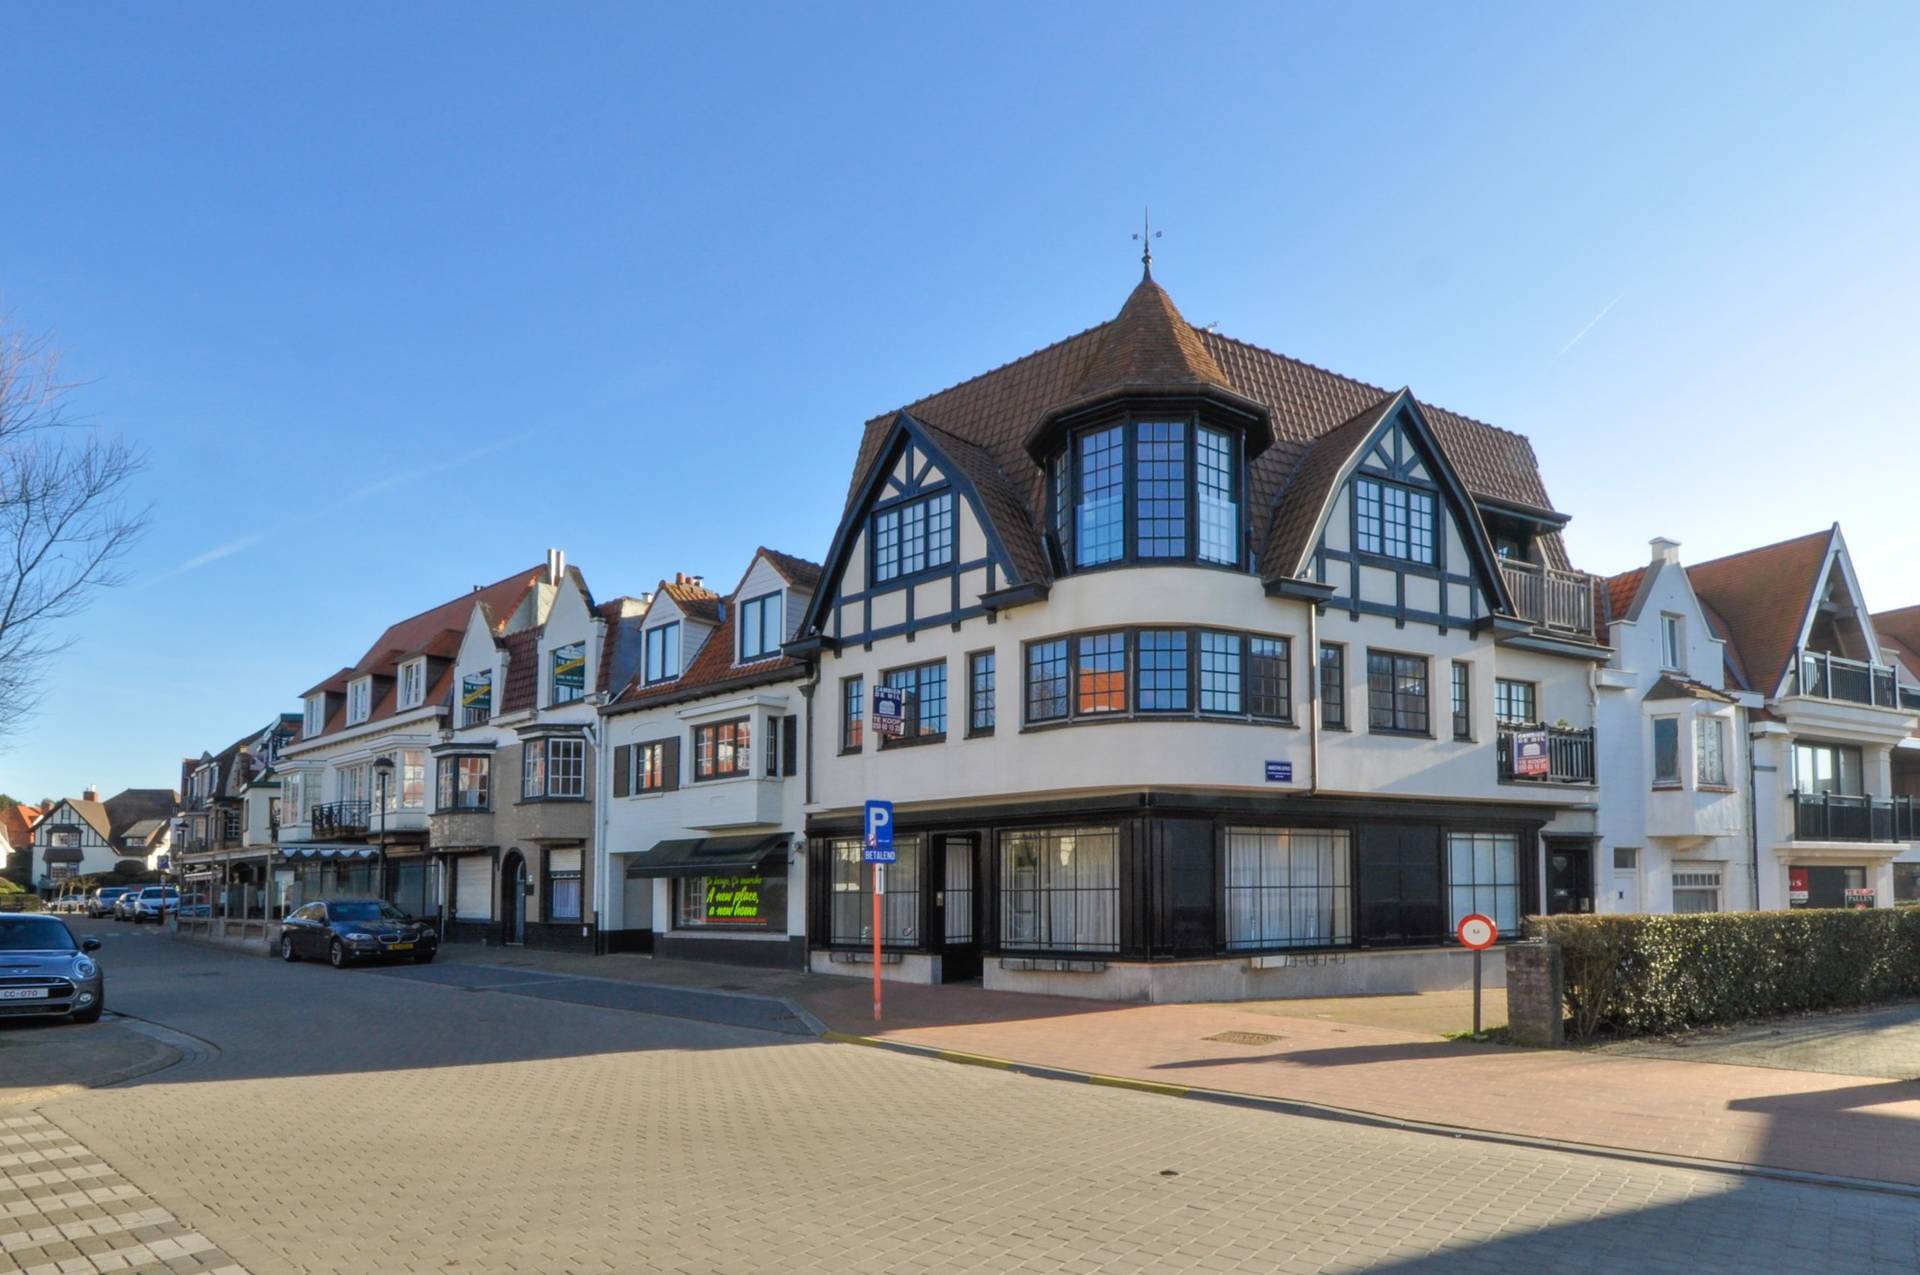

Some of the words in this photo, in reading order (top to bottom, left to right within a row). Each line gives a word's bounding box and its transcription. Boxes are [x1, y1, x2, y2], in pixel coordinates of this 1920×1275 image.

[870, 807, 889, 846] P
[865, 850, 896, 860] BETALEND
[706, 886, 716, 903] A
[716, 892, 733, 902] new
[732, 886, 759, 906] place,
[716, 906, 733, 917] new
[733, 900, 758, 917] home
